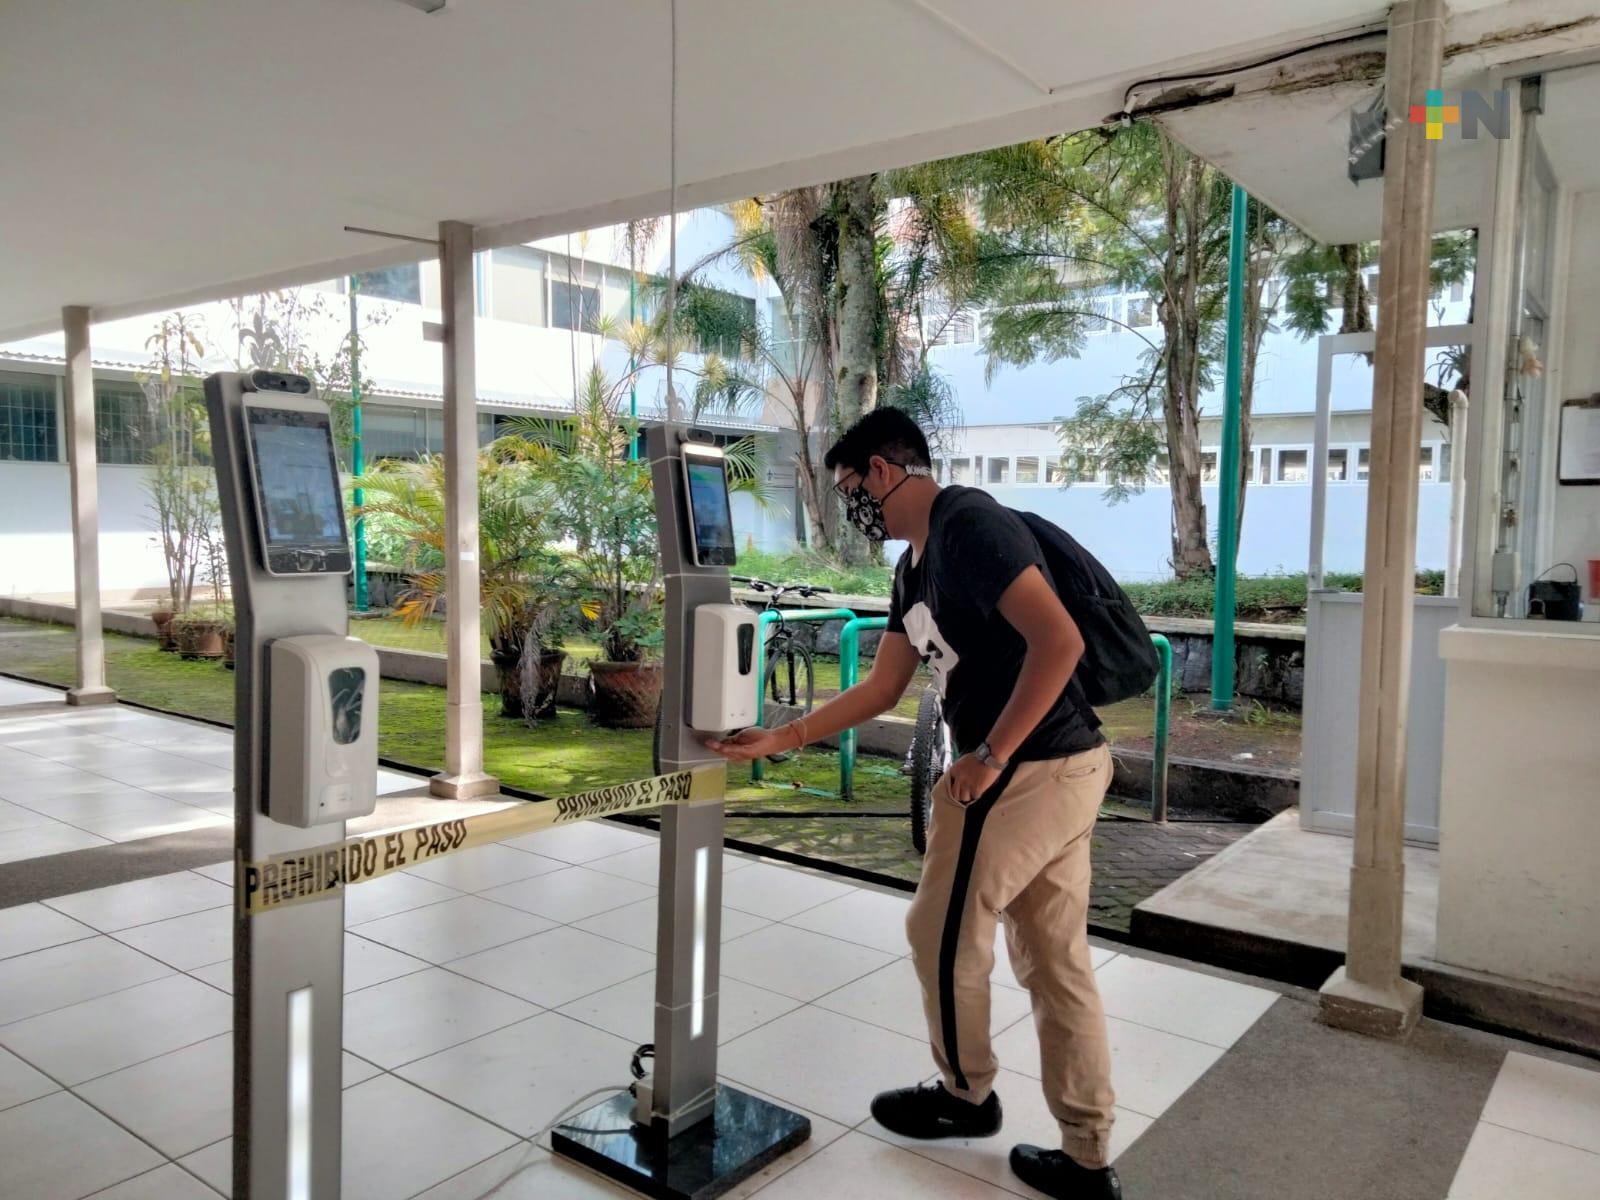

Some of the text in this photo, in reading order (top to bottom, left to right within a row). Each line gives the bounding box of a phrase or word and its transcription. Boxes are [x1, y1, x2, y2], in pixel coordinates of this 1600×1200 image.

[553, 771, 692, 823] PROHIBIDO EL PASO
[245, 819, 467, 909] PROHIBIDO EL PASO
